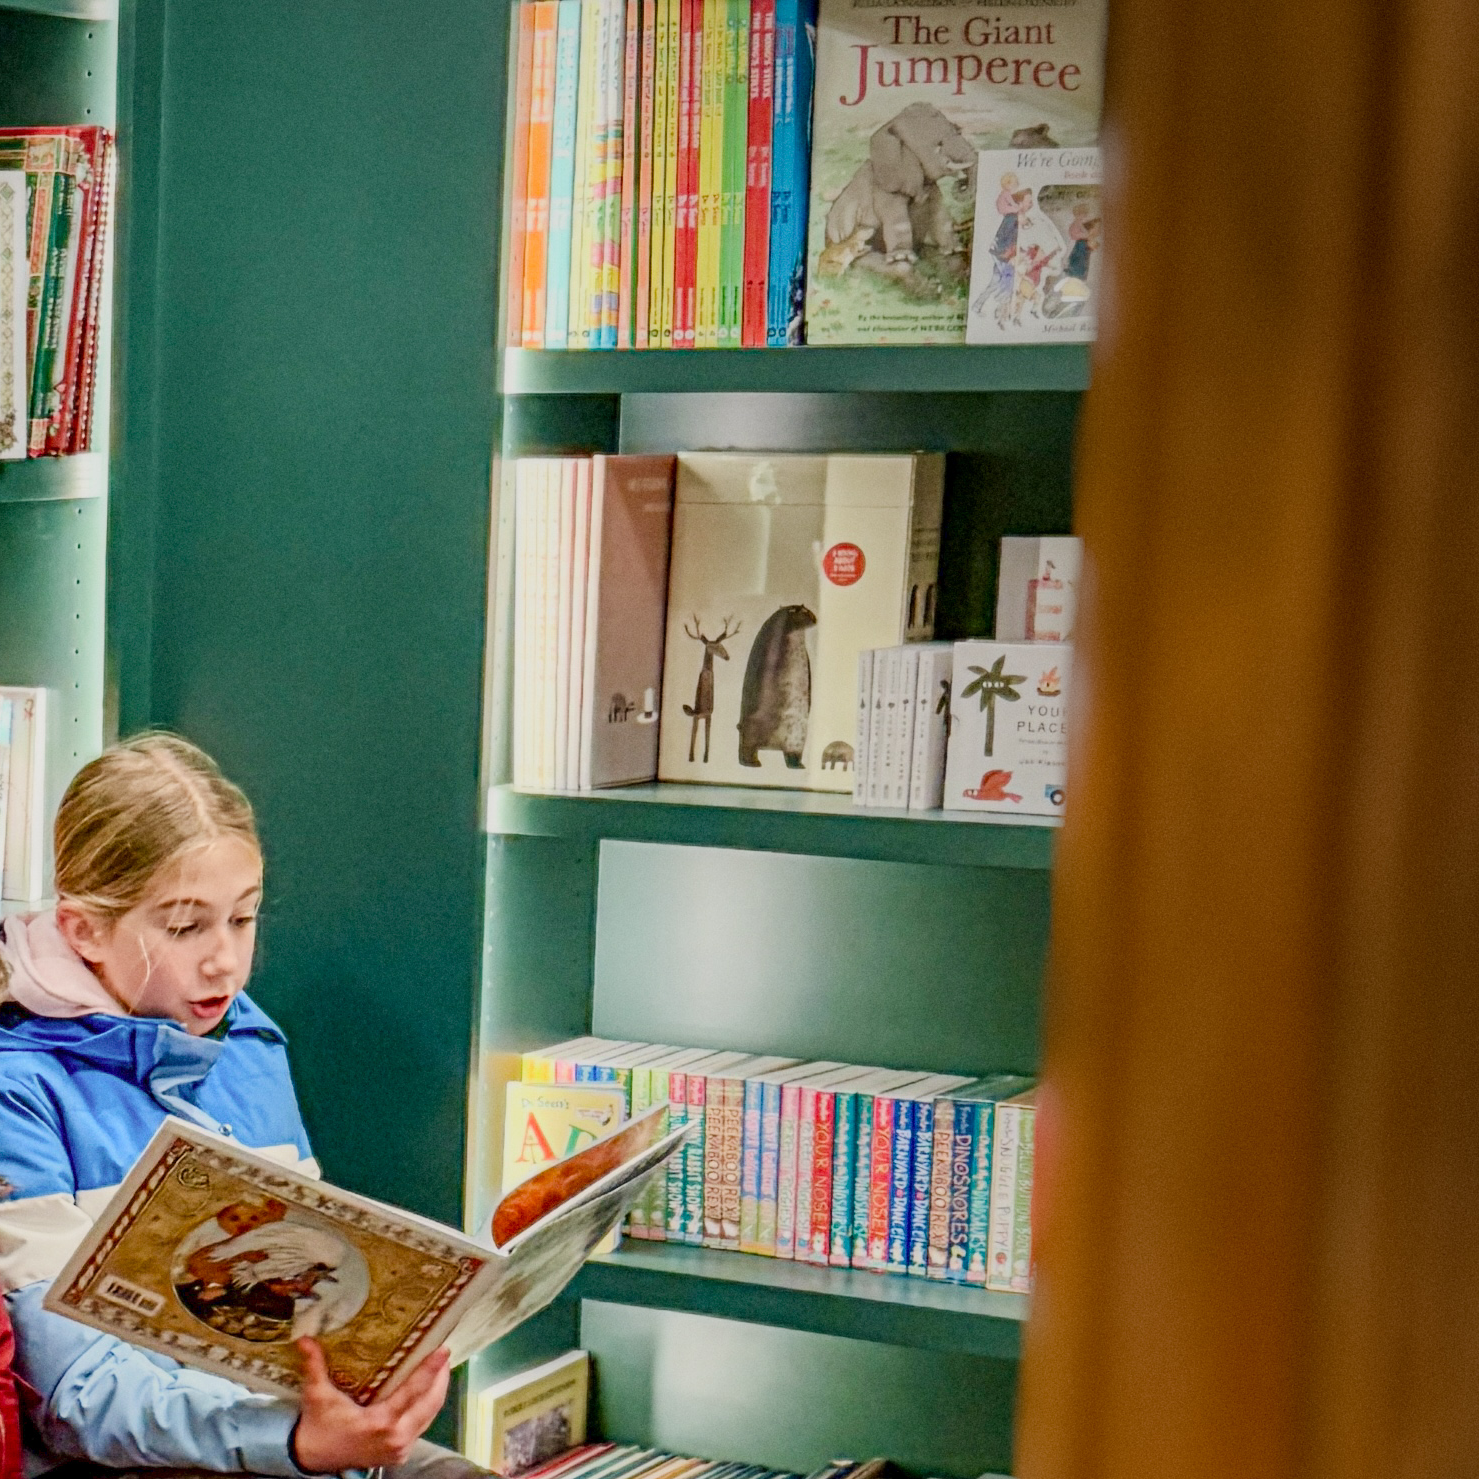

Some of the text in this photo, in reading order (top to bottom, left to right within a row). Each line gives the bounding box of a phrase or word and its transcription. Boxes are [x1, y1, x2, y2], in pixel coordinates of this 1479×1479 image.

[882, 15, 1054, 47] The Giant
[838, 44, 1081, 107] Jumperee
[705, 1107, 721, 1183] PEEKABOO
[723, 1108, 739, 1185] PEEKABOO
[811, 1120, 831, 1231] YOUR NOSE!
[871, 1125, 891, 1237] YOUR NOSE!
[894, 1129, 912, 1190] BARNYARD
[915, 1131, 933, 1192] BARNYARD
[935, 1131, 951, 1209] PEEKABOO
[950, 1134, 973, 1245] DINOSNORES
